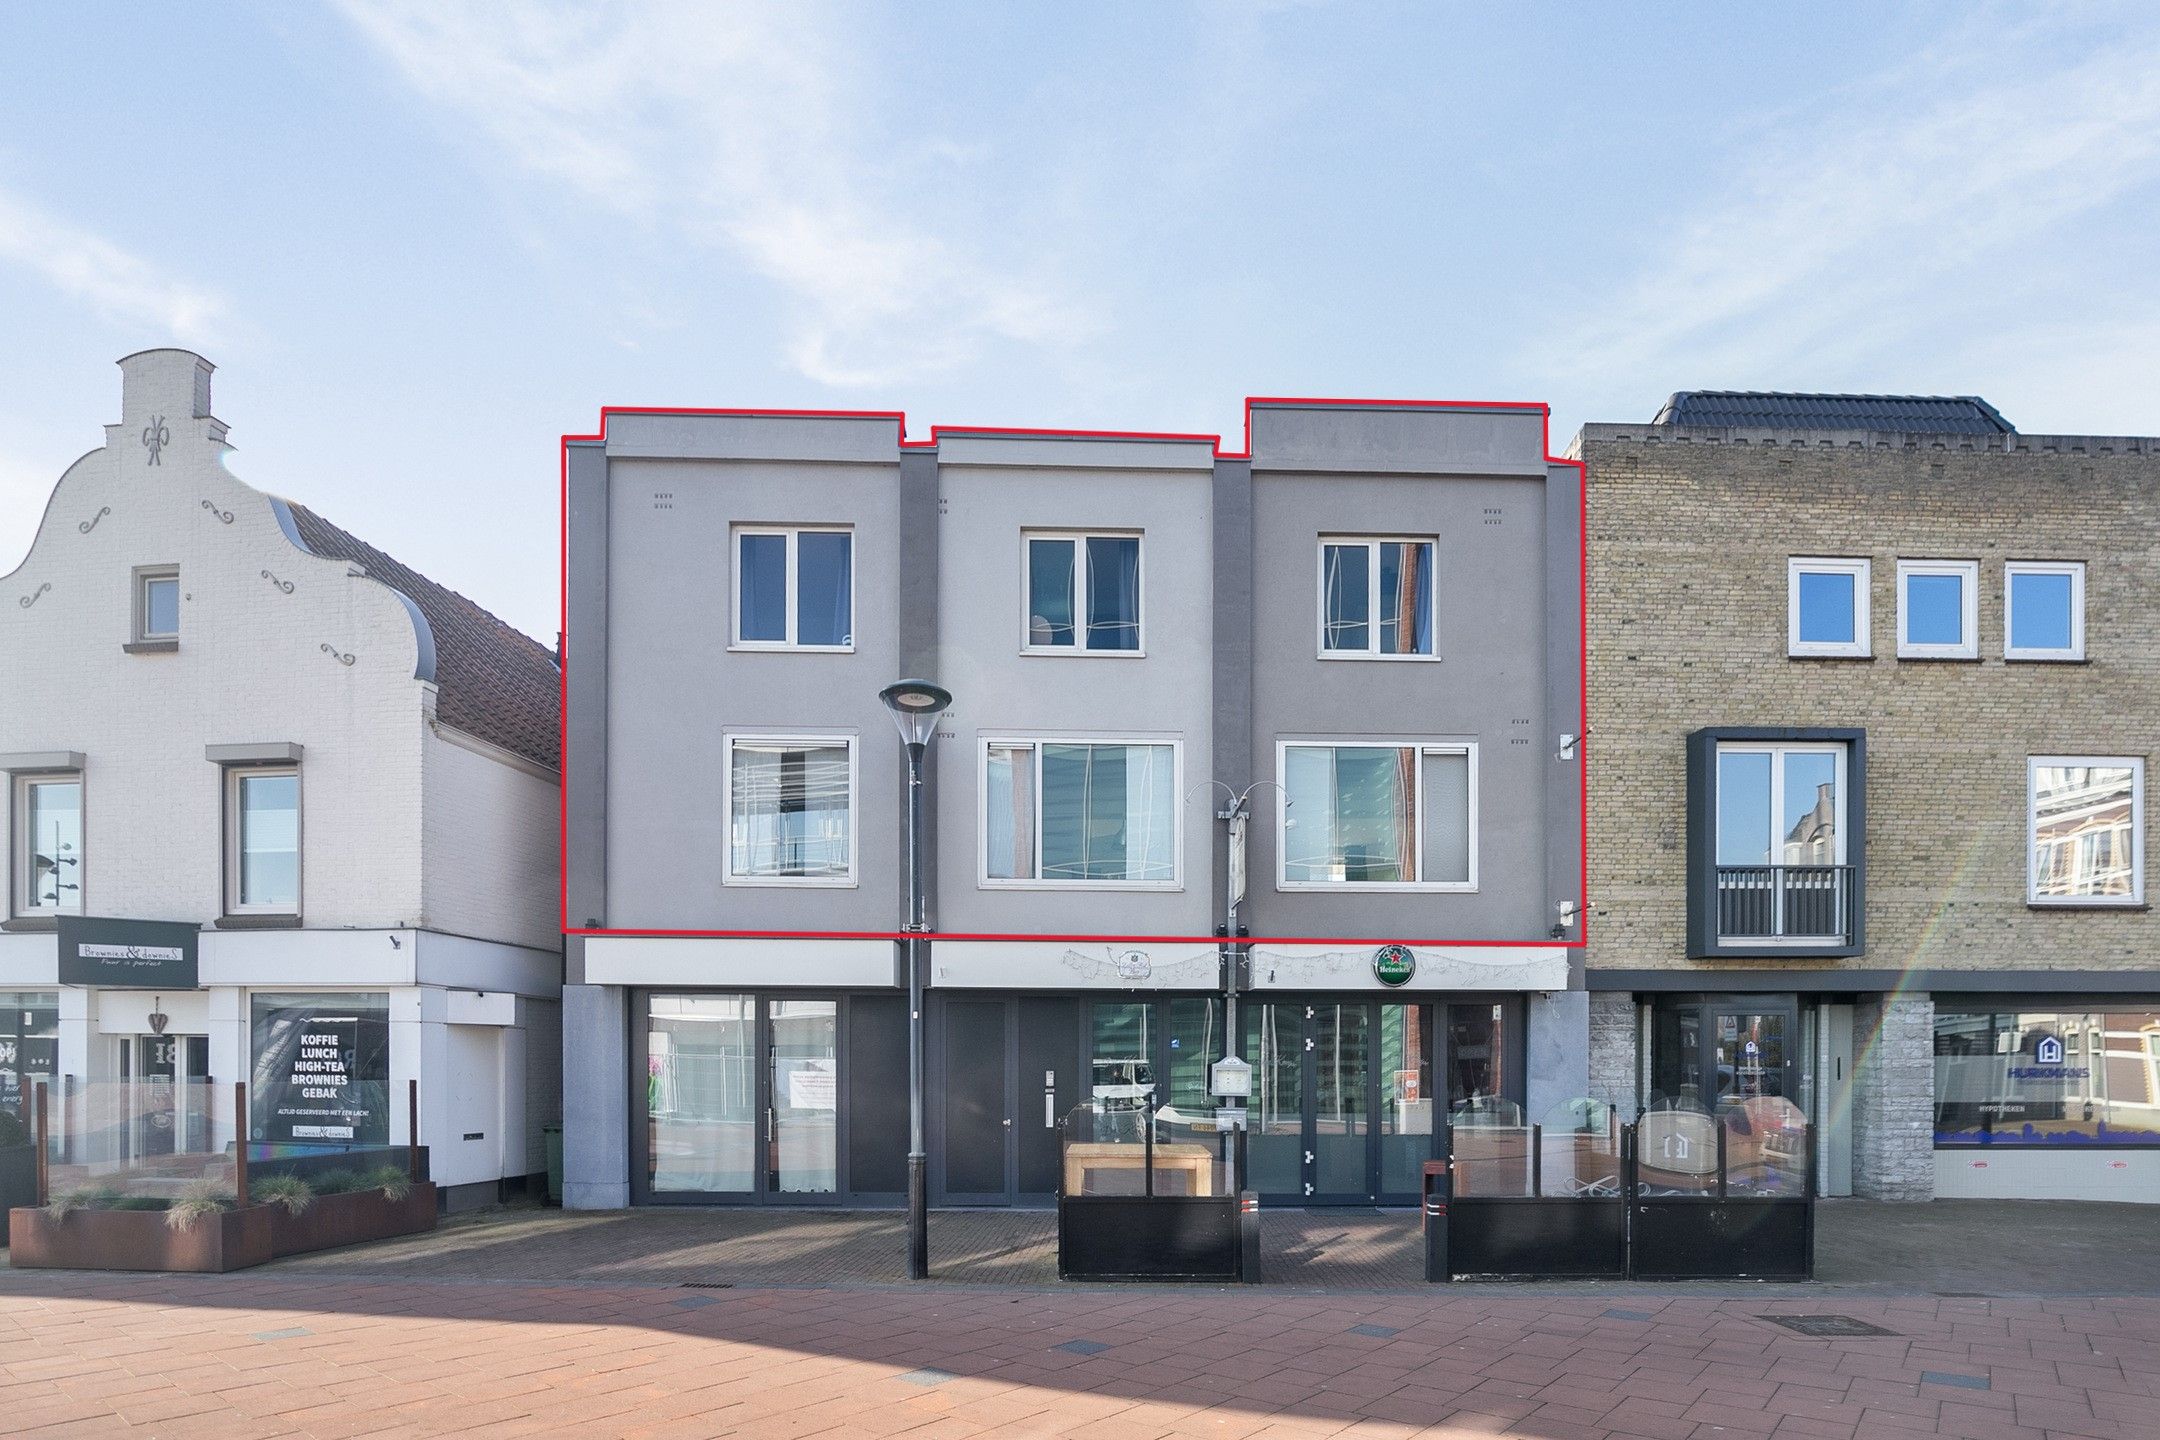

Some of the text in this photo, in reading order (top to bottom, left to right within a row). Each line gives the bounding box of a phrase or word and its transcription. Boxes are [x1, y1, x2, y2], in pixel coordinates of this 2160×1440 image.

[84, 945, 125, 957] Brownies
[301, 1034, 338, 1046] KOFFIE
[301, 1047, 338, 1059] LUNCH
[294, 1060, 346, 1072] HIGH-TEA
[2007, 1067, 2091, 1079] HURKMANS
[291, 1074, 348, 1085] BROWNIES
[302, 1087, 338, 1098] GEBAK
[296, 1108, 330, 1116] GESERVEERD
